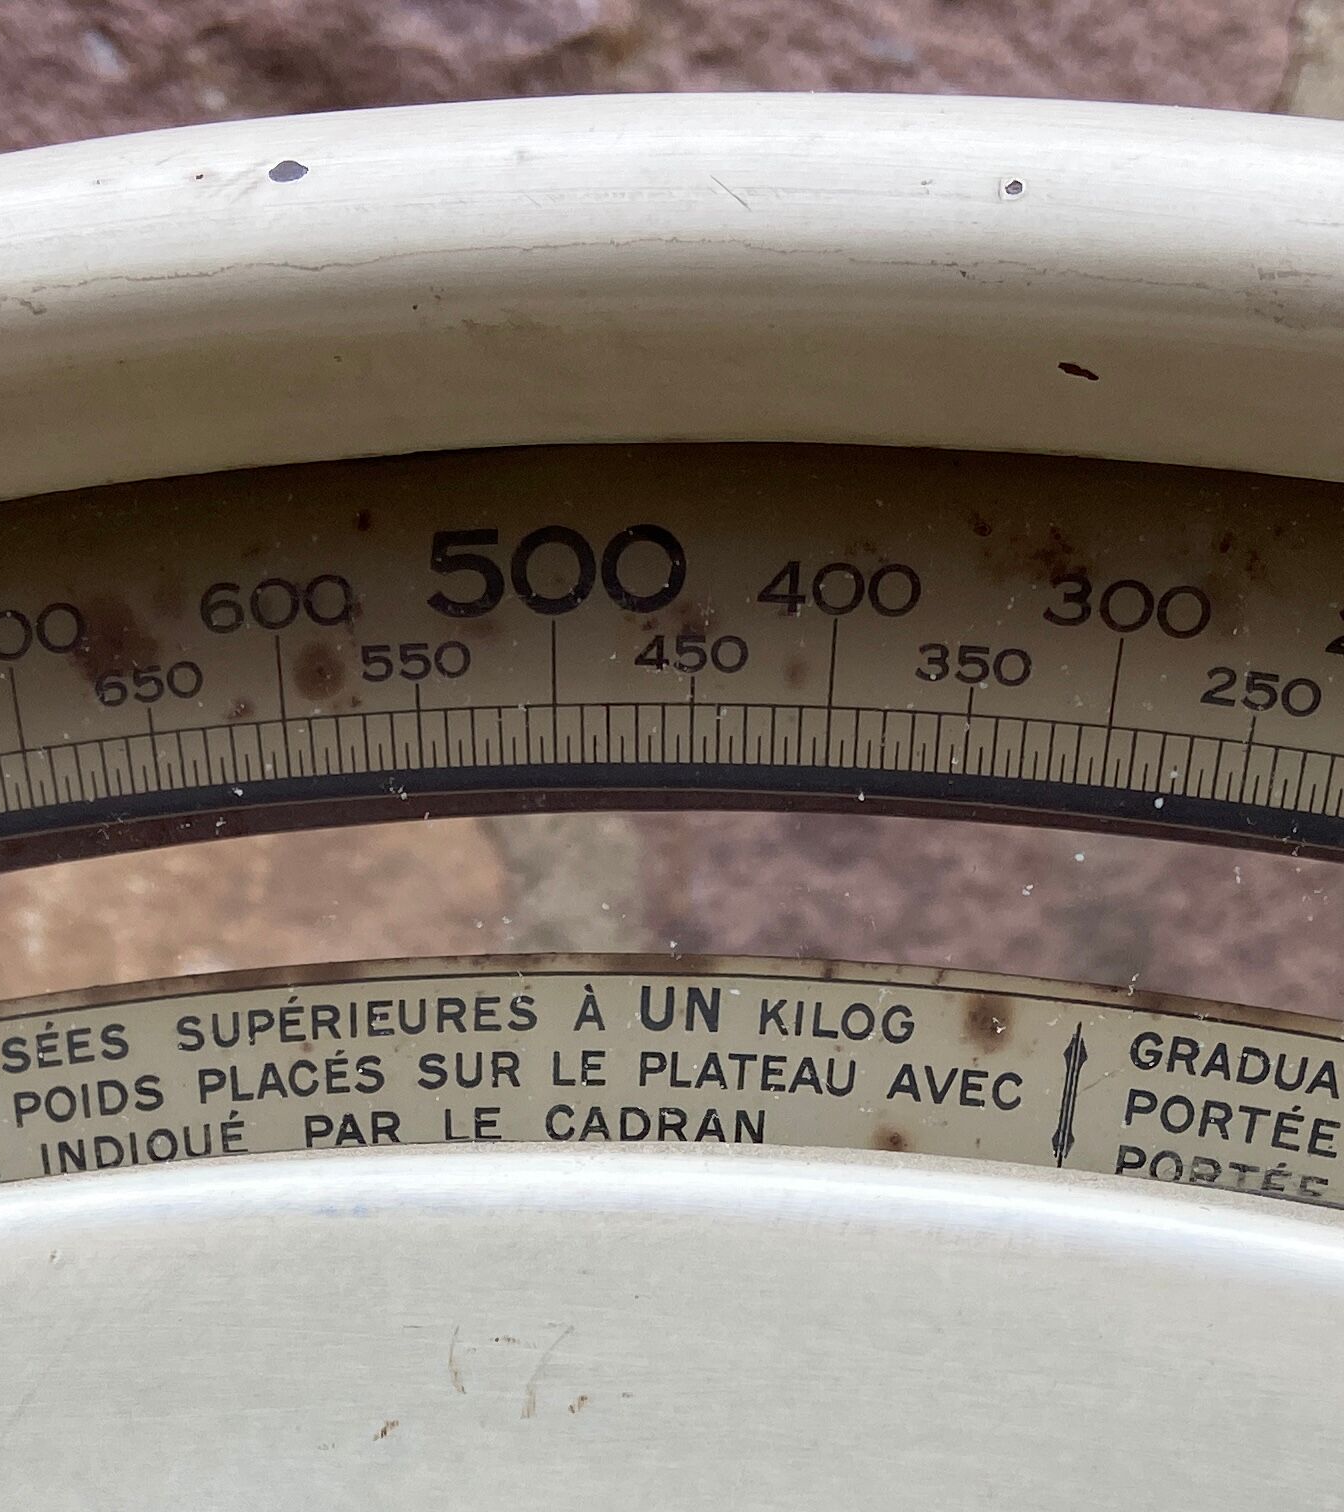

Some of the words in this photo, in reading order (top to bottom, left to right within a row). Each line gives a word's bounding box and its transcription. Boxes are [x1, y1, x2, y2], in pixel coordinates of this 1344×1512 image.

[200, 573, 353, 634] 600
[426, 523, 687, 618] 500
[756, 560, 922, 618] 400
[1042, 573, 1211, 640] 300
[94, 661, 204, 707] 650
[360, 640, 471, 683] 550
[634, 634, 749, 674] 450
[914, 643, 1033, 687] 350
[1199, 665, 1323, 718] 250
[176, 995, 538, 1052] SUPÉRIEURES
[573, 983, 607, 1033] À
[639, 985, 722, 1033] UN
[759, 997, 916, 1044] KILOG
[15, 1074, 165, 1129] POIDS
[198, 1050, 386, 1104] PLACÉS
[417, 1051, 522, 1091] SUR
[553, 1050, 607, 1088] LE
[639, 1050, 857, 1098] PLATEAU
[886, 1063, 1024, 1112] AVEC
[304, 1110, 402, 1149] PAR
[444, 1106, 502, 1142] LE
[545, 1103, 766, 1144] CADRAN
[1124, 1088, 1343, 1159] PORTÉE
